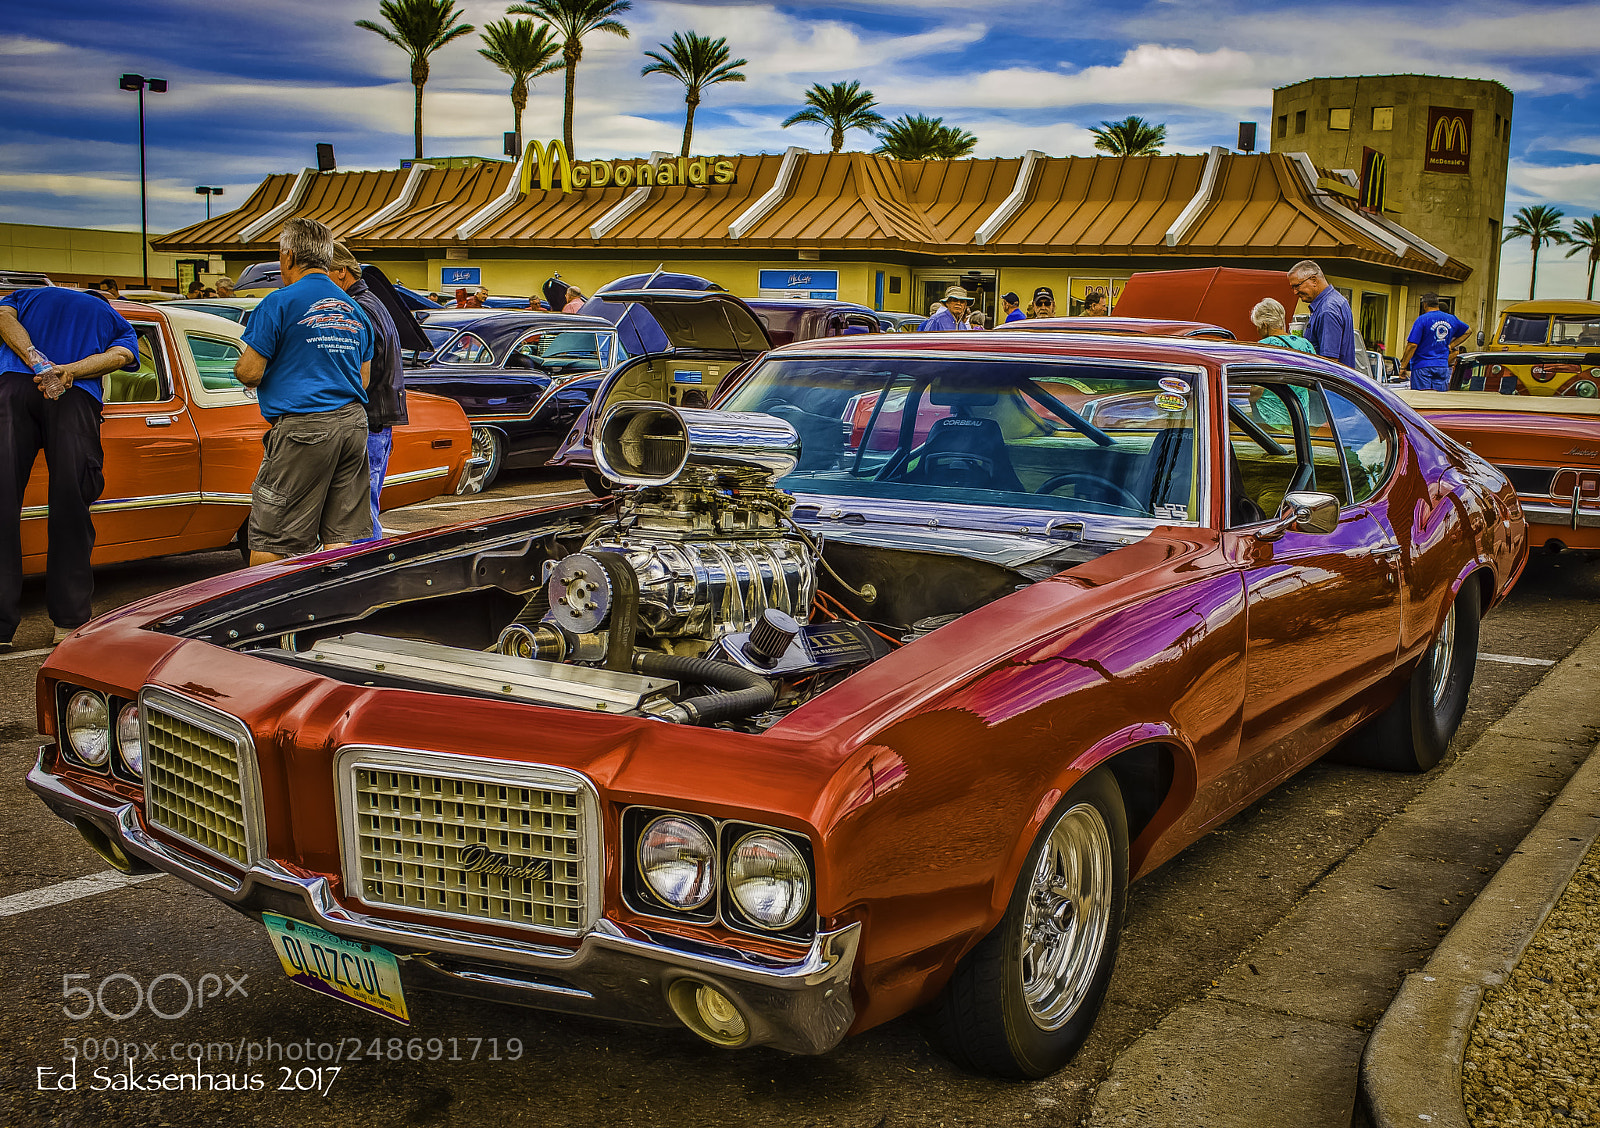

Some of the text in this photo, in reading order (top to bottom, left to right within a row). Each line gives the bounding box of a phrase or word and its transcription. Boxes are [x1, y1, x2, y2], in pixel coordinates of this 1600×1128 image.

[520, 139, 736, 195] McDonald's
[1430, 157, 1465, 166] McDonald's
[460, 845, 549, 880] Oldsmobile
[281, 935, 391, 1002] OLDZCUL
